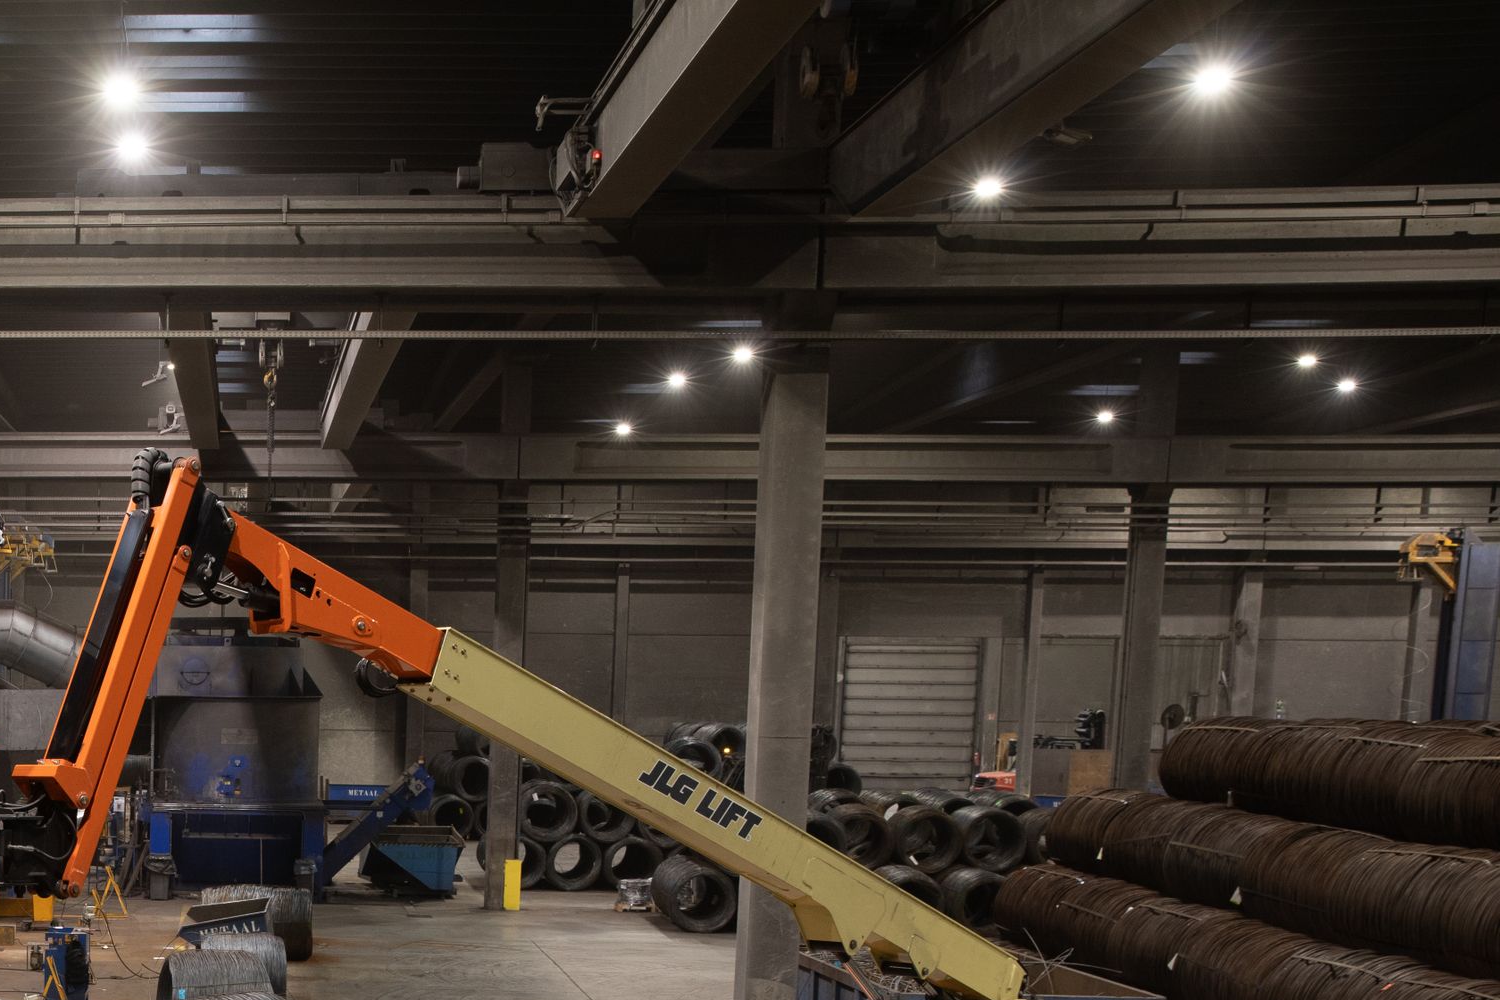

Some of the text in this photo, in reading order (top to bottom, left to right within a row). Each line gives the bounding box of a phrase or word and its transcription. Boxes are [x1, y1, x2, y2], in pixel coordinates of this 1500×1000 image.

[348, 789, 380, 797] METAAL
[637, 759, 763, 840] JLG LIFT
